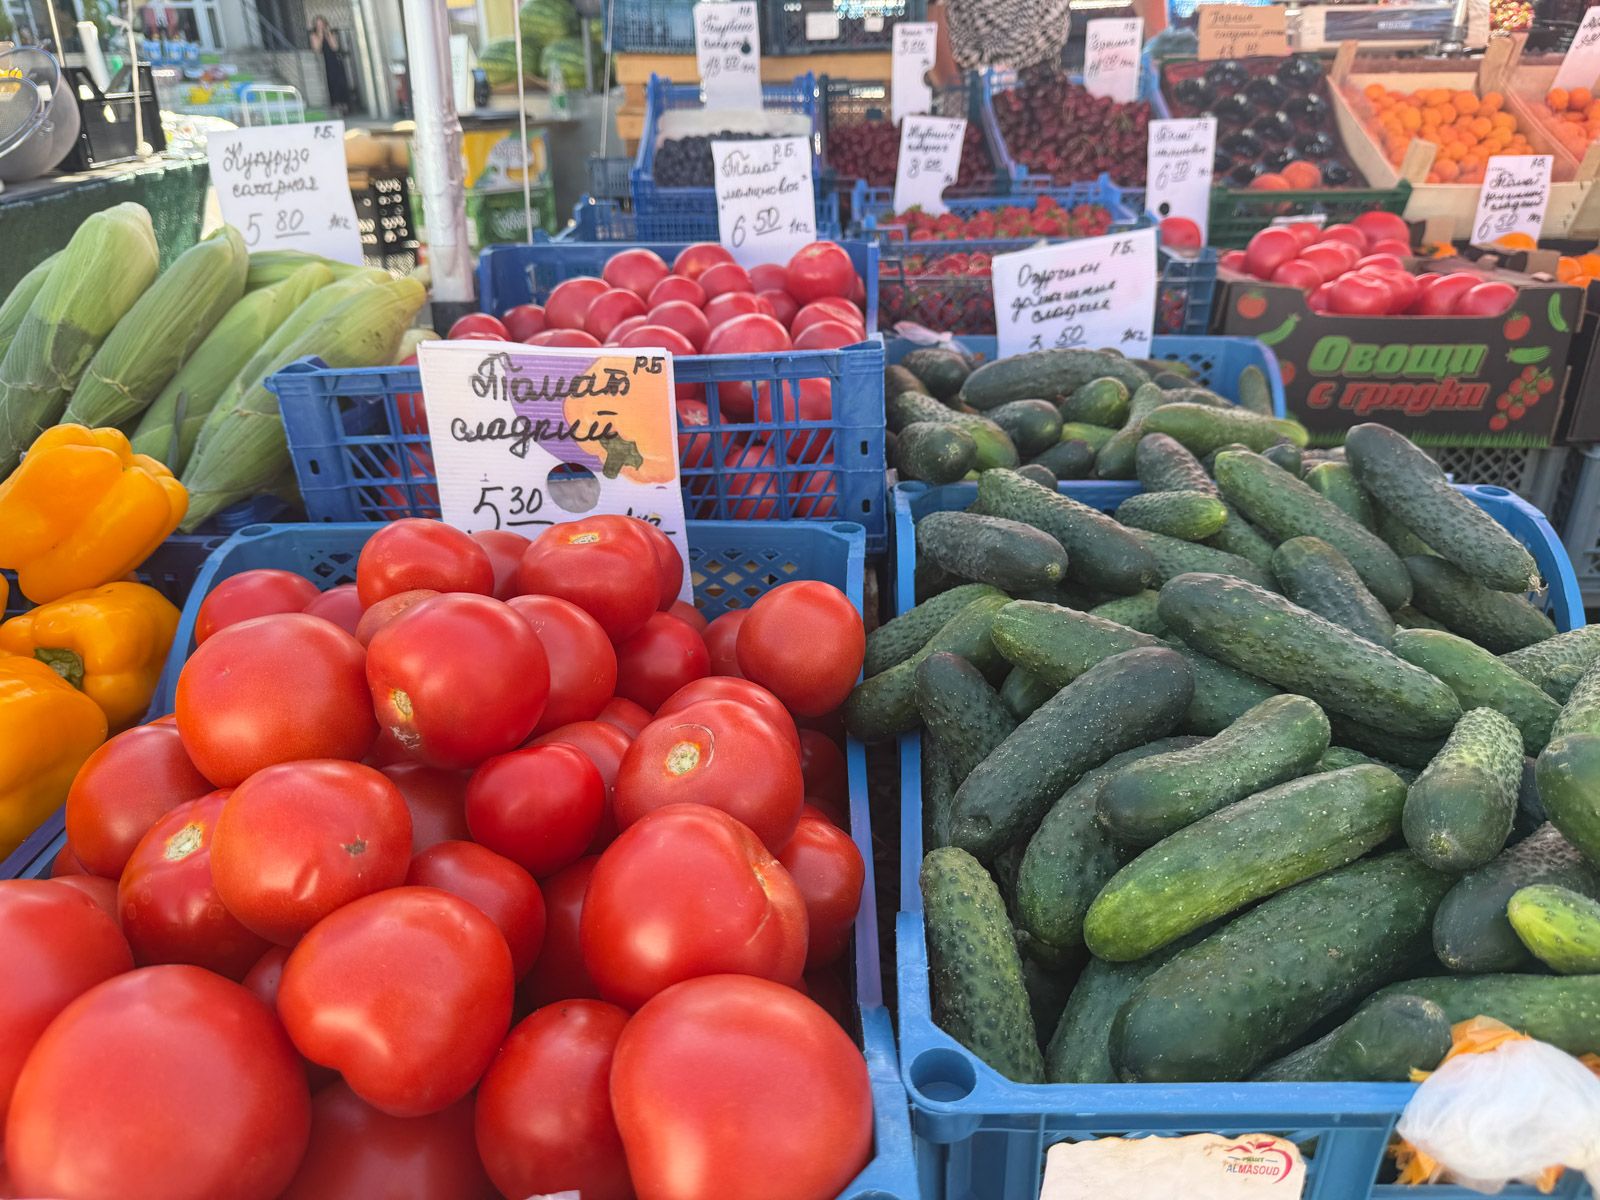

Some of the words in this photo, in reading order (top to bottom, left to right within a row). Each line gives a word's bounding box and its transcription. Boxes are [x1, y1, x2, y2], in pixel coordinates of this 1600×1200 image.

[222, 141, 310, 180] Кукуруза
[721, 150, 782, 178] Томат
[232, 177, 319, 202] сахарная
[244, 213, 263, 247] 5
[275, 209, 305, 232] 80
[731, 215, 747, 249] 6
[753, 206, 780, 233] 50
[1477, 214, 1494, 241] 6
[1017, 262, 1101, 296] Огурчики
[1056, 324, 1084, 346] 50
[1307, 335, 1489, 381] Овощи
[471, 352, 631, 404] Томат
[1306, 380, 1338, 409] с
[1338, 376, 1491, 416] грядки
[450, 410, 619, 459] сладкий
[472, 486, 504, 532] 5
[509, 486, 543, 515] 30
[1226, 1163, 1280, 1176] ALMASOUD
